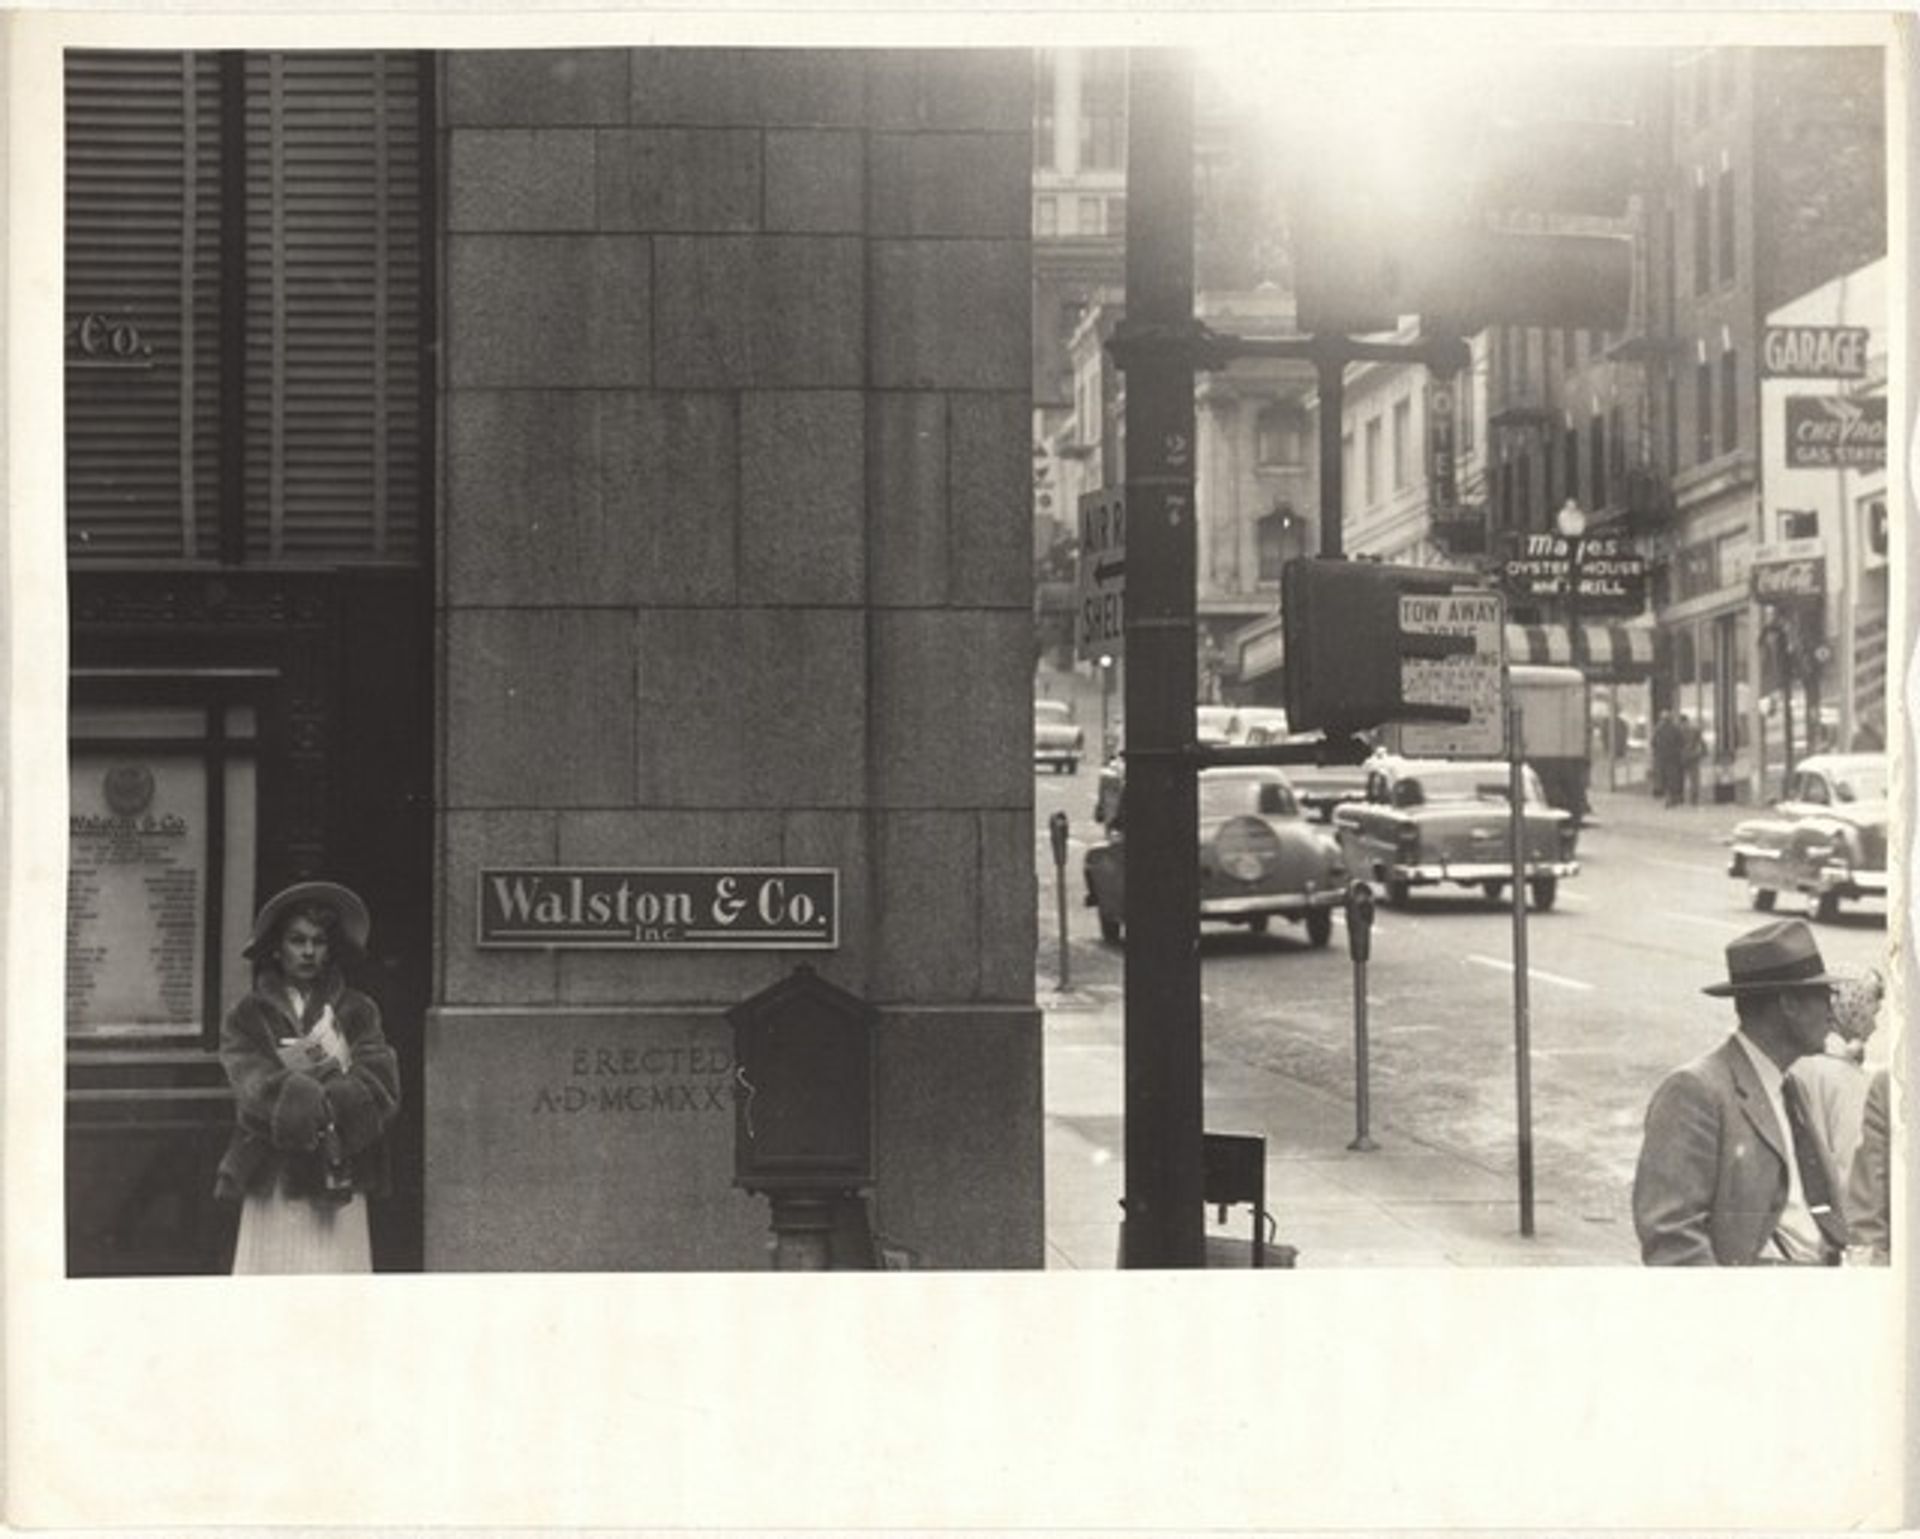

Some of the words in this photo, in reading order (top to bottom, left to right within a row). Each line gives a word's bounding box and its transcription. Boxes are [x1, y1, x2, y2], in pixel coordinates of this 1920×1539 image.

[1765, 329, 1864, 371] GARAGE
[1403, 601, 1440, 622] TOW
[1448, 600, 1499, 622] AWAY
[493, 876, 696, 924] Walston
[712, 876, 748, 925] &
[757, 878, 827, 925] Co.
[572, 1047, 731, 1076] ERECTED
